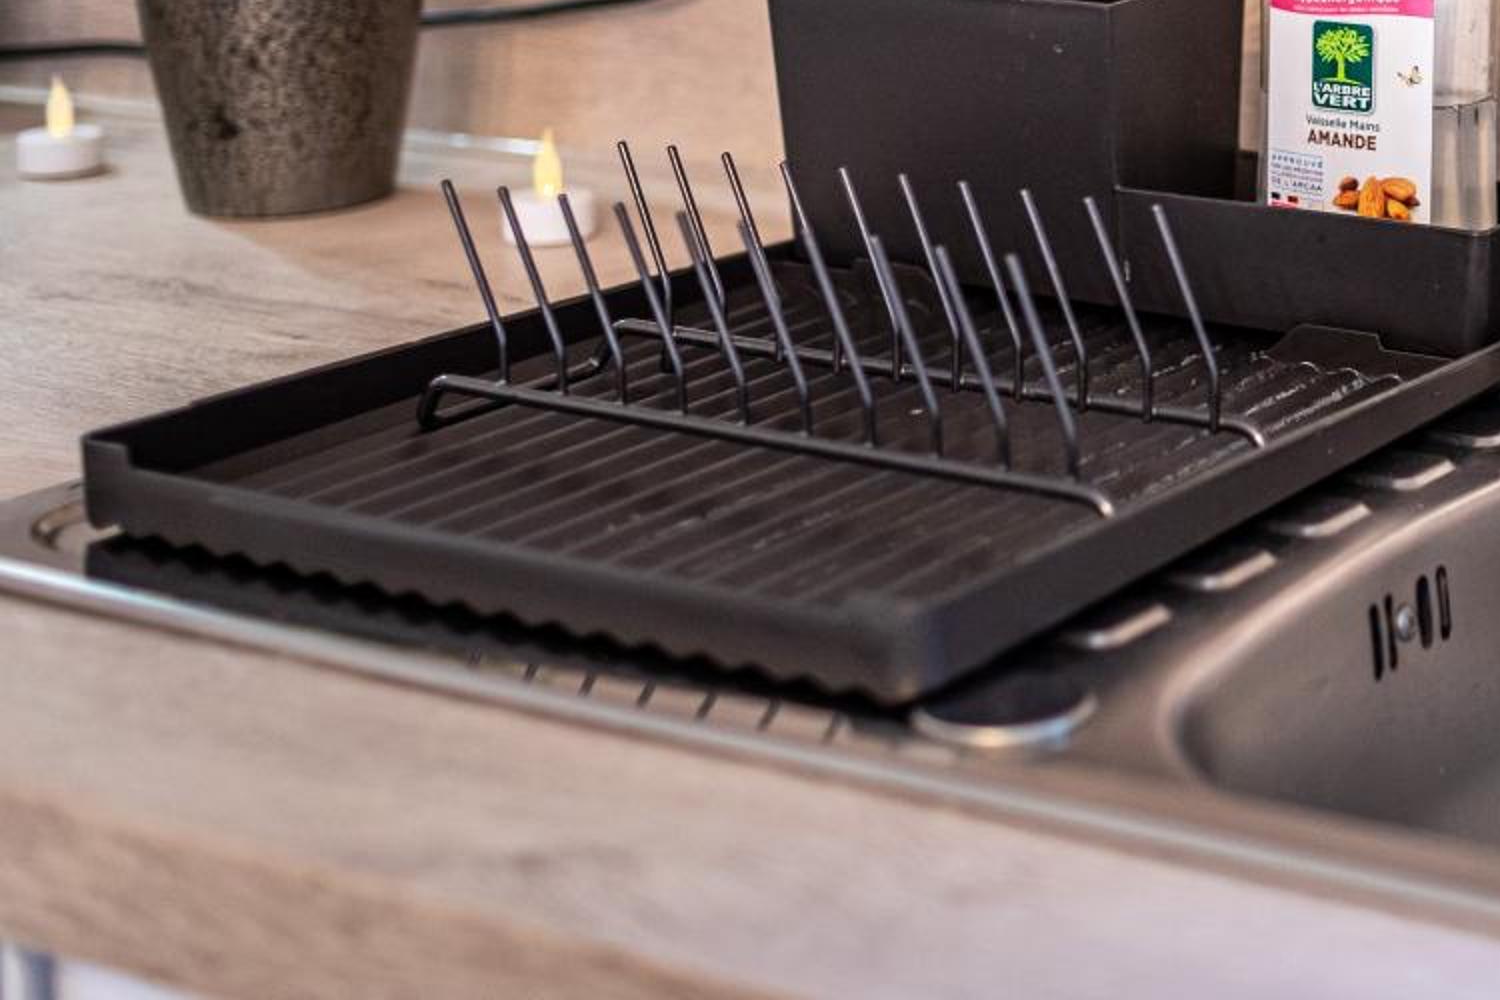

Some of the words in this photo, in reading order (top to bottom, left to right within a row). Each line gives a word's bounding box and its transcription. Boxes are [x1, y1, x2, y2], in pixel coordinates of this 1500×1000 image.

[1313, 81, 1371, 97] L'ARBRE
[1314, 94, 1370, 109] VERT
[1306, 113, 1347, 128] Vaisselle
[1349, 120, 1380, 132] Mains
[1307, 129, 1377, 151] AMANDE
